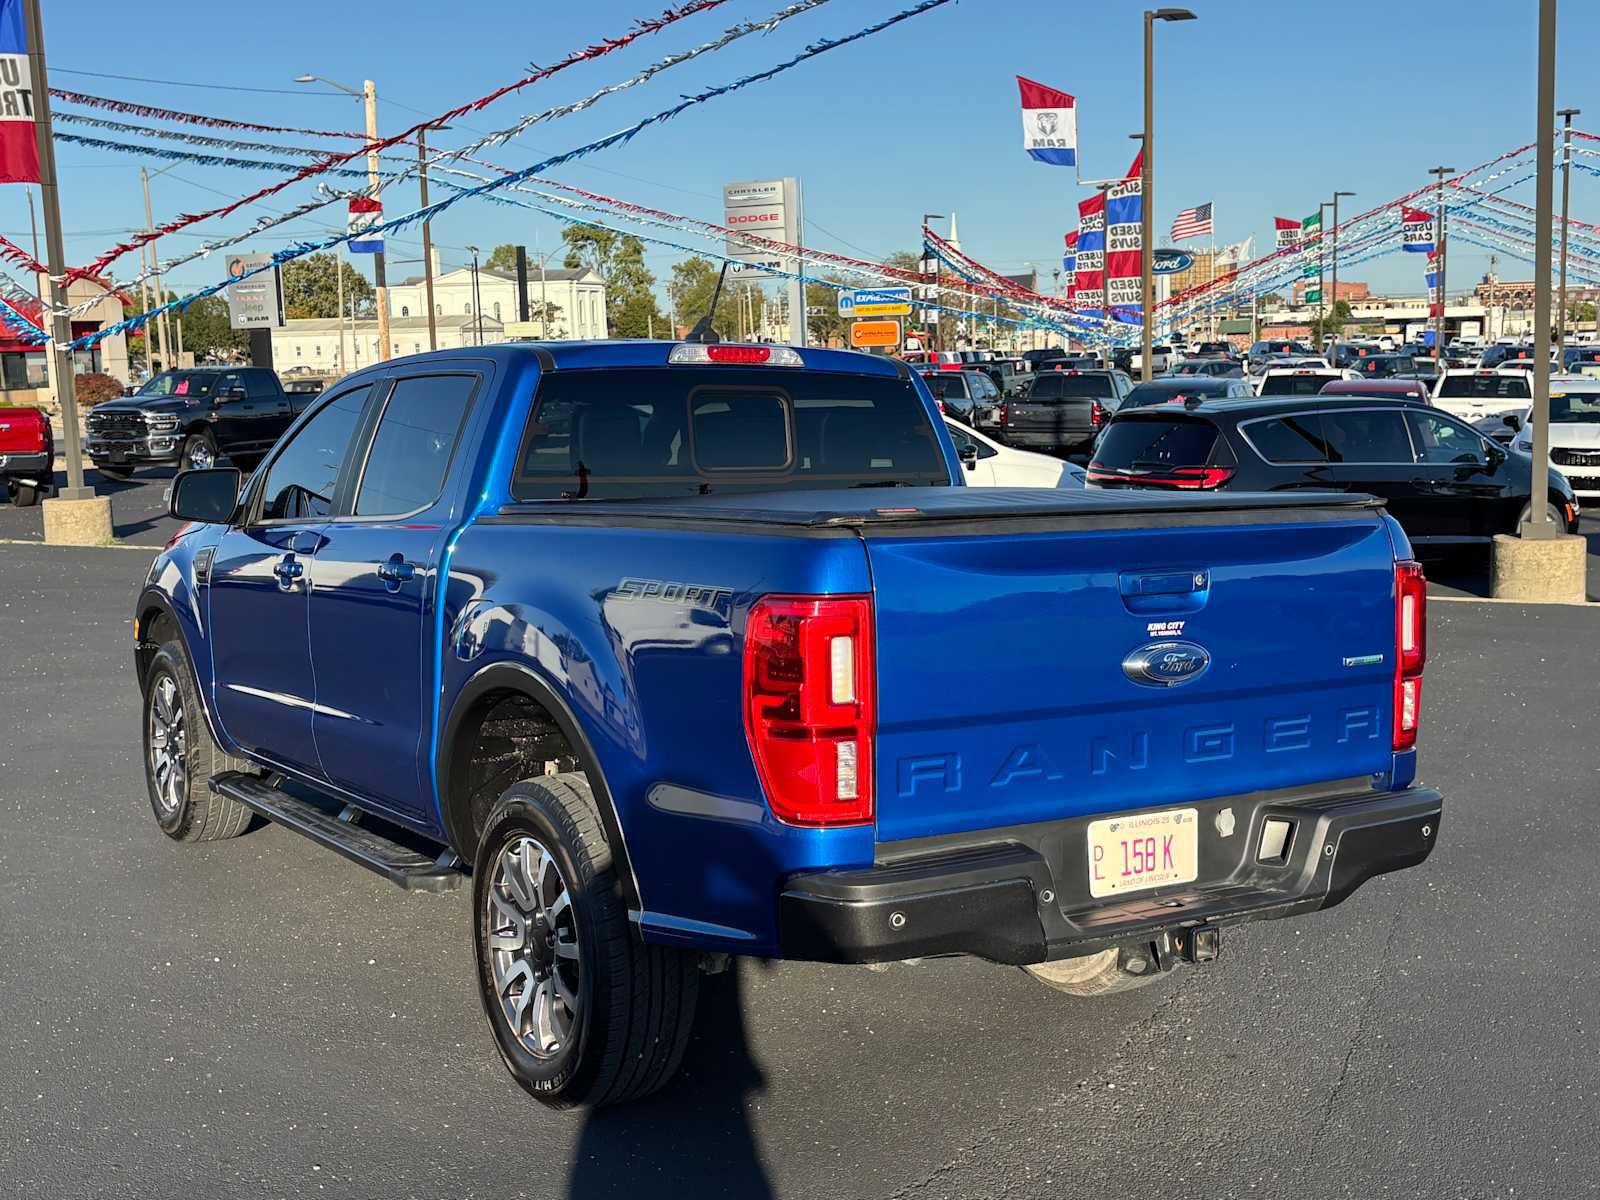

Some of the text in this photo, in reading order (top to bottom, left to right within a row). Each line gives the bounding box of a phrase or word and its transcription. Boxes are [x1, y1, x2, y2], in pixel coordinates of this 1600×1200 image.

[728, 186, 776, 195] CHRYSLER
[728, 213, 780, 224] DODGE
[606, 577, 735, 607] SPORT
[1147, 621, 1185, 631] KING CITY
[1160, 653, 1196, 672] Ford
[897, 705, 1380, 797] RANGER
[1128, 818, 1160, 829] ILLINOIS
[1120, 834, 1174, 876] 158 K
